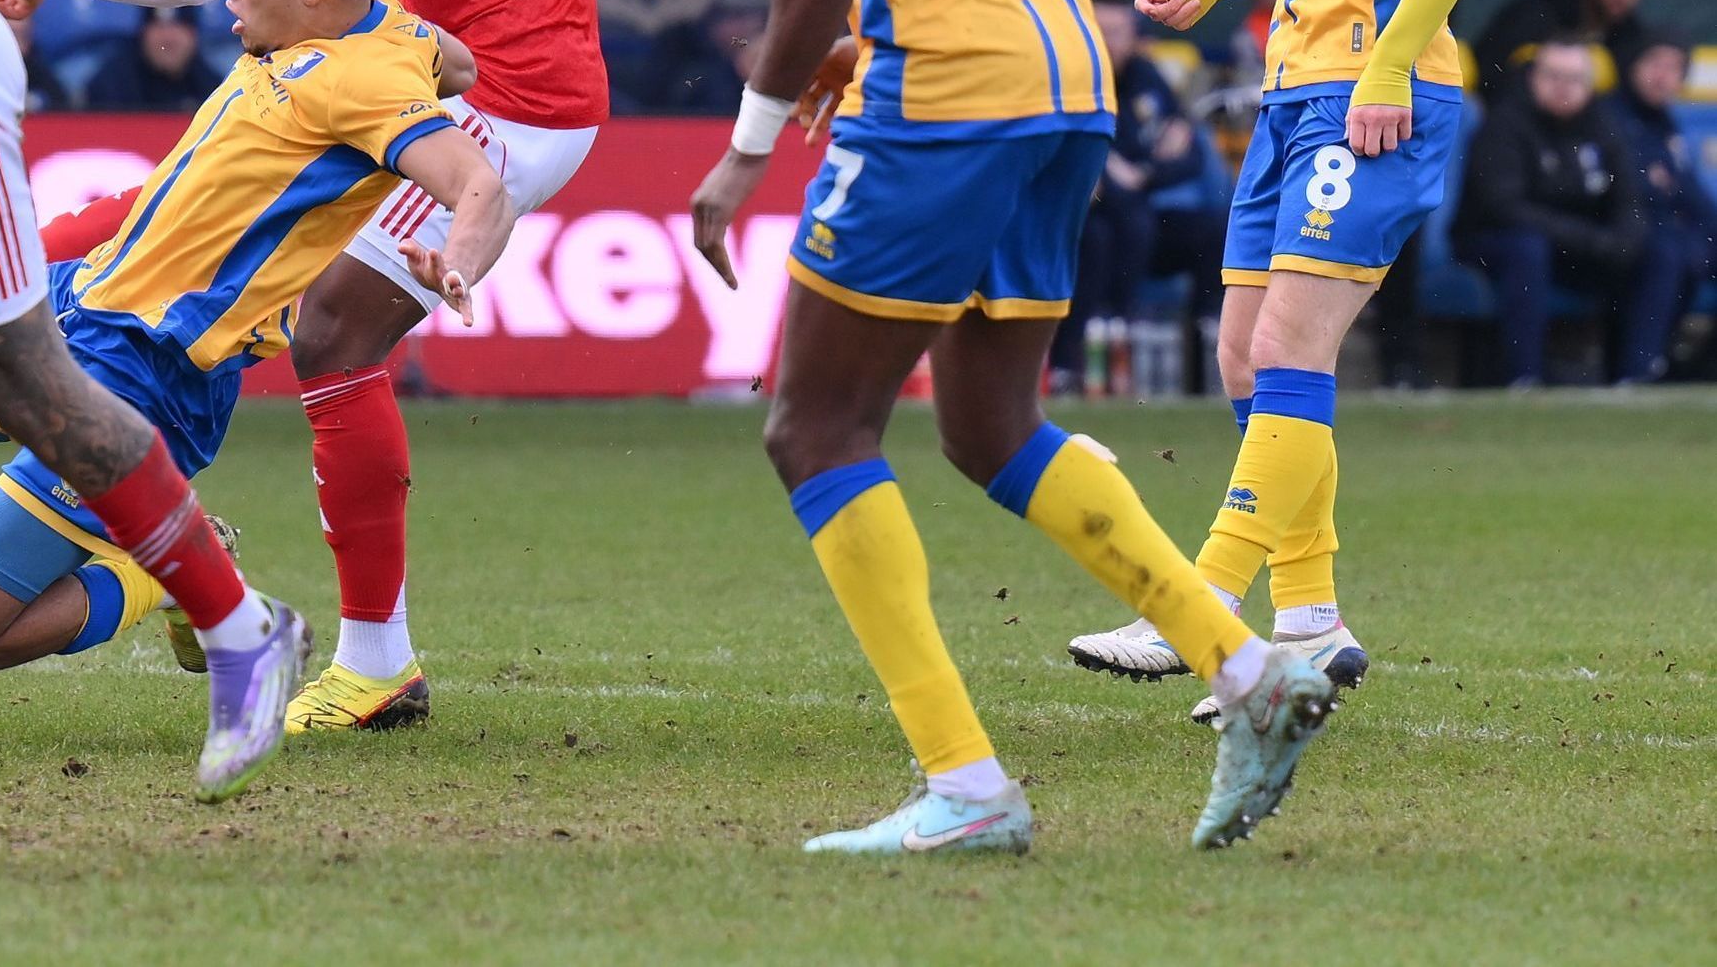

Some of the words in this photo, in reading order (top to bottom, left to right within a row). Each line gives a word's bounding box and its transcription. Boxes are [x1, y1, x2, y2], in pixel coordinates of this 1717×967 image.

[811, 146, 864, 221] 7
[1305, 144, 1356, 211] 8
[1299, 225, 1330, 241] errea
[51, 485, 80, 510] errea
